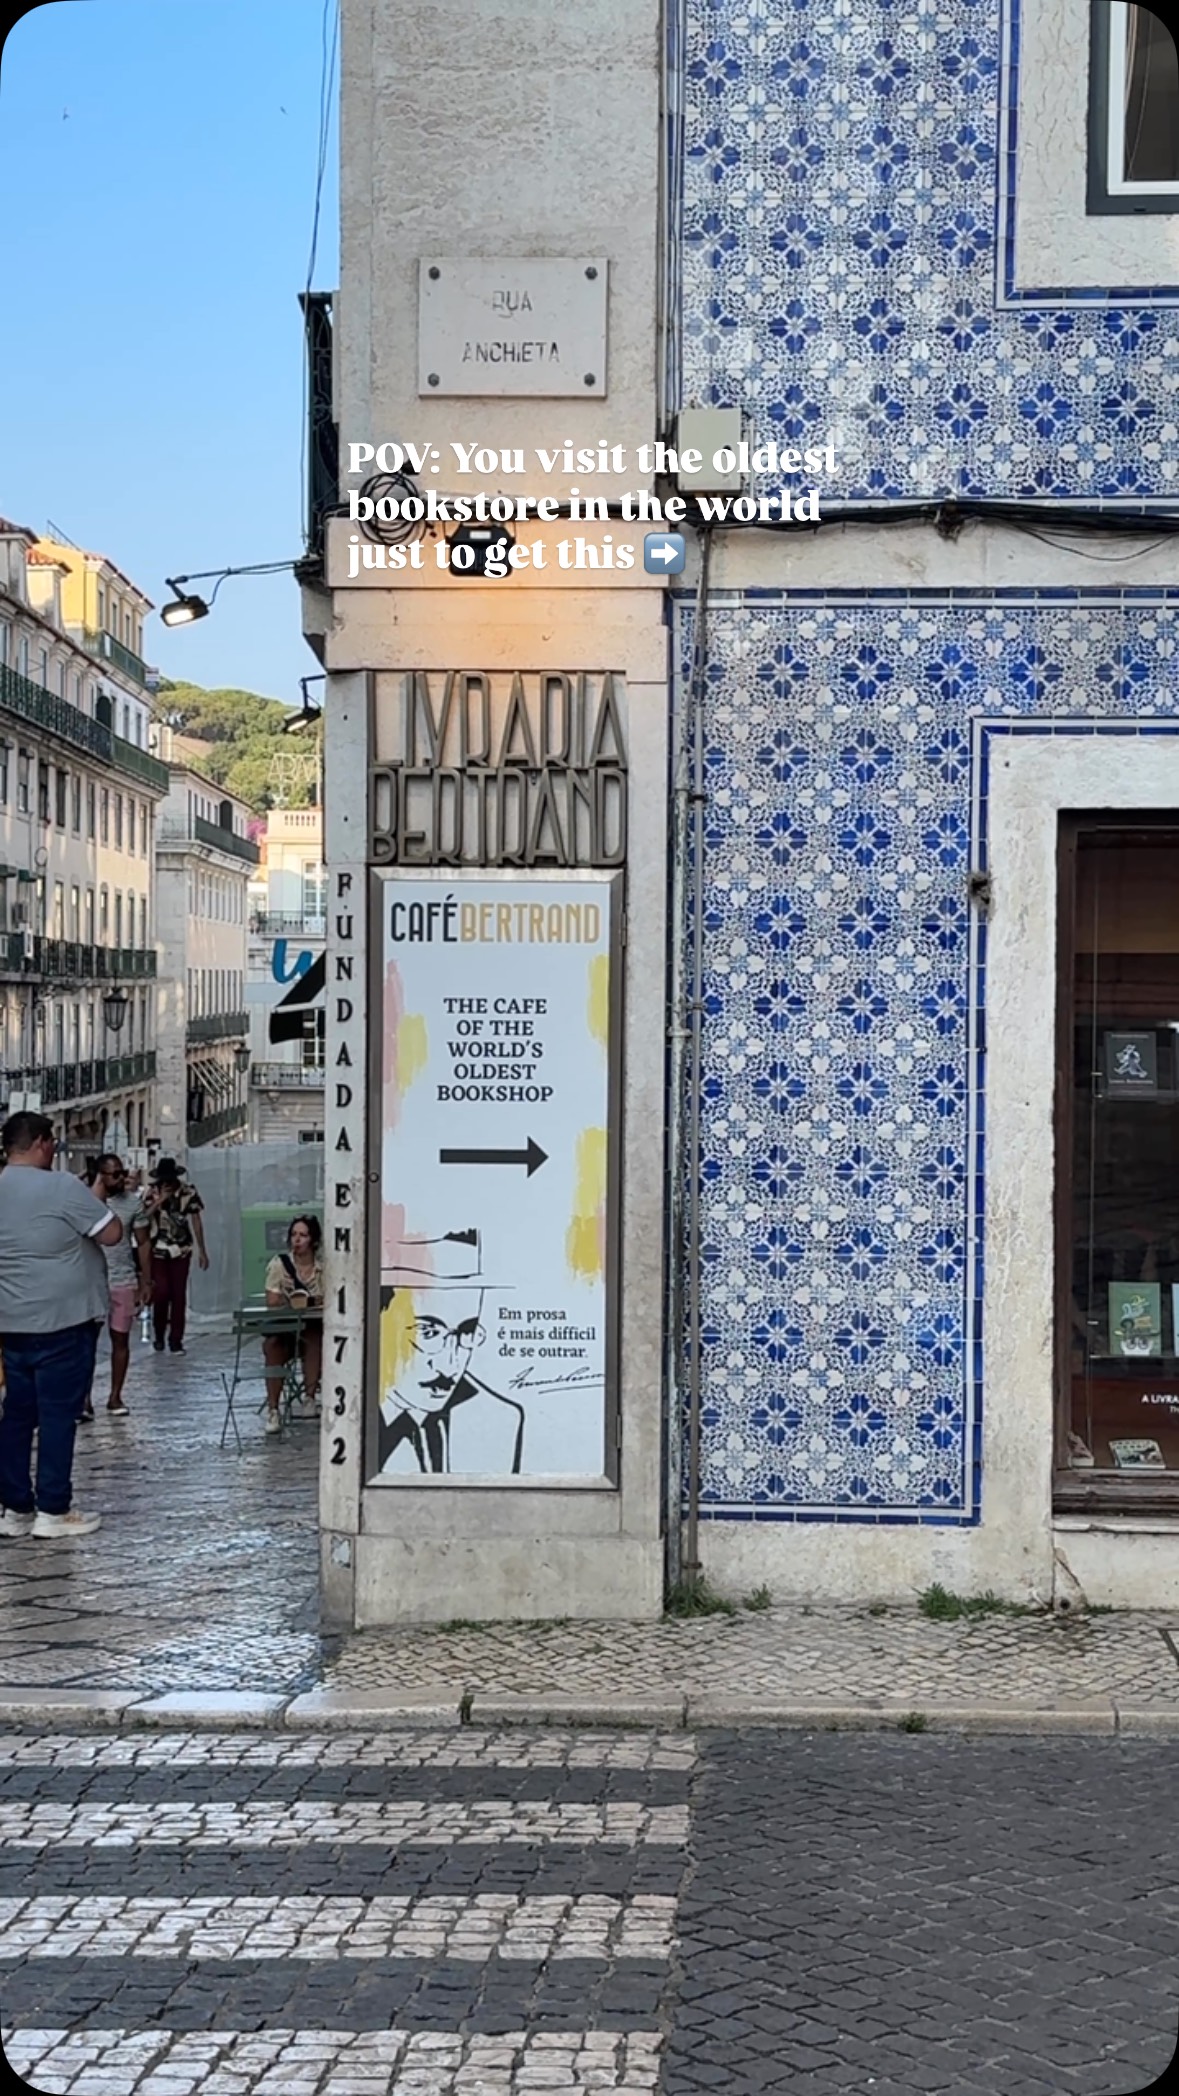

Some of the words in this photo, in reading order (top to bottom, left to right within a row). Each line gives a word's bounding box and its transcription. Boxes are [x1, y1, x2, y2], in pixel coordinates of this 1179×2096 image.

[492, 290, 533, 312] RUA
[462, 341, 560, 363] ANCHIETA
[366, 671, 628, 768] LIVRARIA
[367, 767, 628, 866] BERTRAND
[335, 872, 354, 1152] FUNDADA
[443, 998, 488, 1014] THE
[493, 998, 547, 1014] CAFE
[456, 1020, 483, 1036] OF
[489, 1020, 534, 1036] THE
[447, 1040, 543, 1058] WORLD'S
[454, 1064, 536, 1080] OLDEST
[437, 1085, 554, 1102] BOOKSHOP
[334, 1183, 351, 1252] EM
[498, 1307, 522, 1320] Em
[527, 1310, 566, 1323] prosa
[497, 1326, 506, 1340] é
[510, 1326, 545, 1340] mais
[498, 1343, 516, 1357] de
[519, 1346, 535, 1357] se
[330, 1284, 348, 1466] 1732
[1141, 1394, 1150, 1404] A
